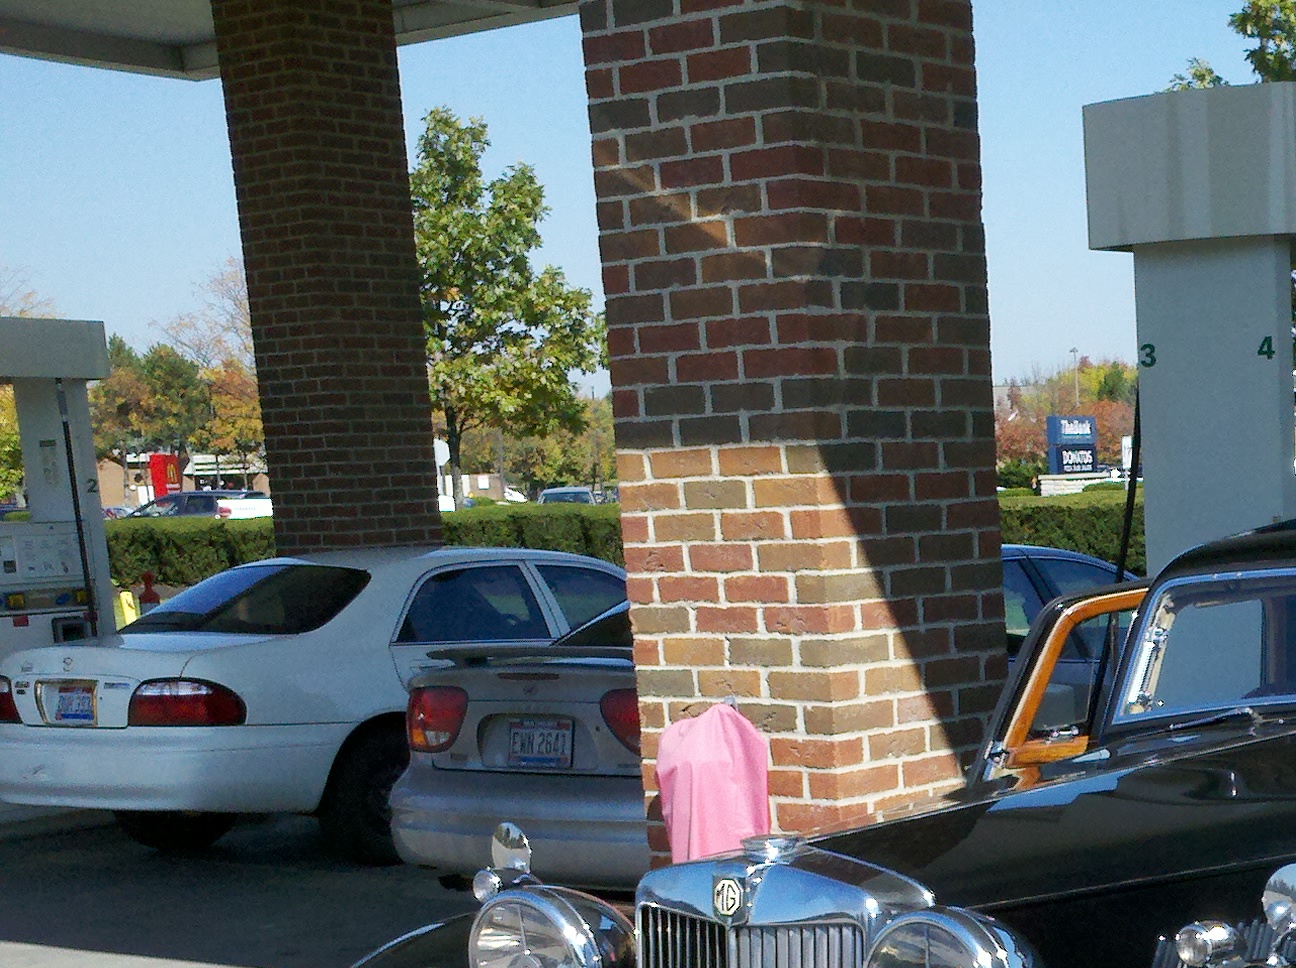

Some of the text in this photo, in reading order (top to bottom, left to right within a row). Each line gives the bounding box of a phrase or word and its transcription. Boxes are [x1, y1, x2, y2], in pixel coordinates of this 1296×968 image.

[1140, 343, 1157, 368] 3
[1256, 335, 1276, 360] 4
[86, 478, 97, 493] 2
[716, 883, 737, 912] MG
